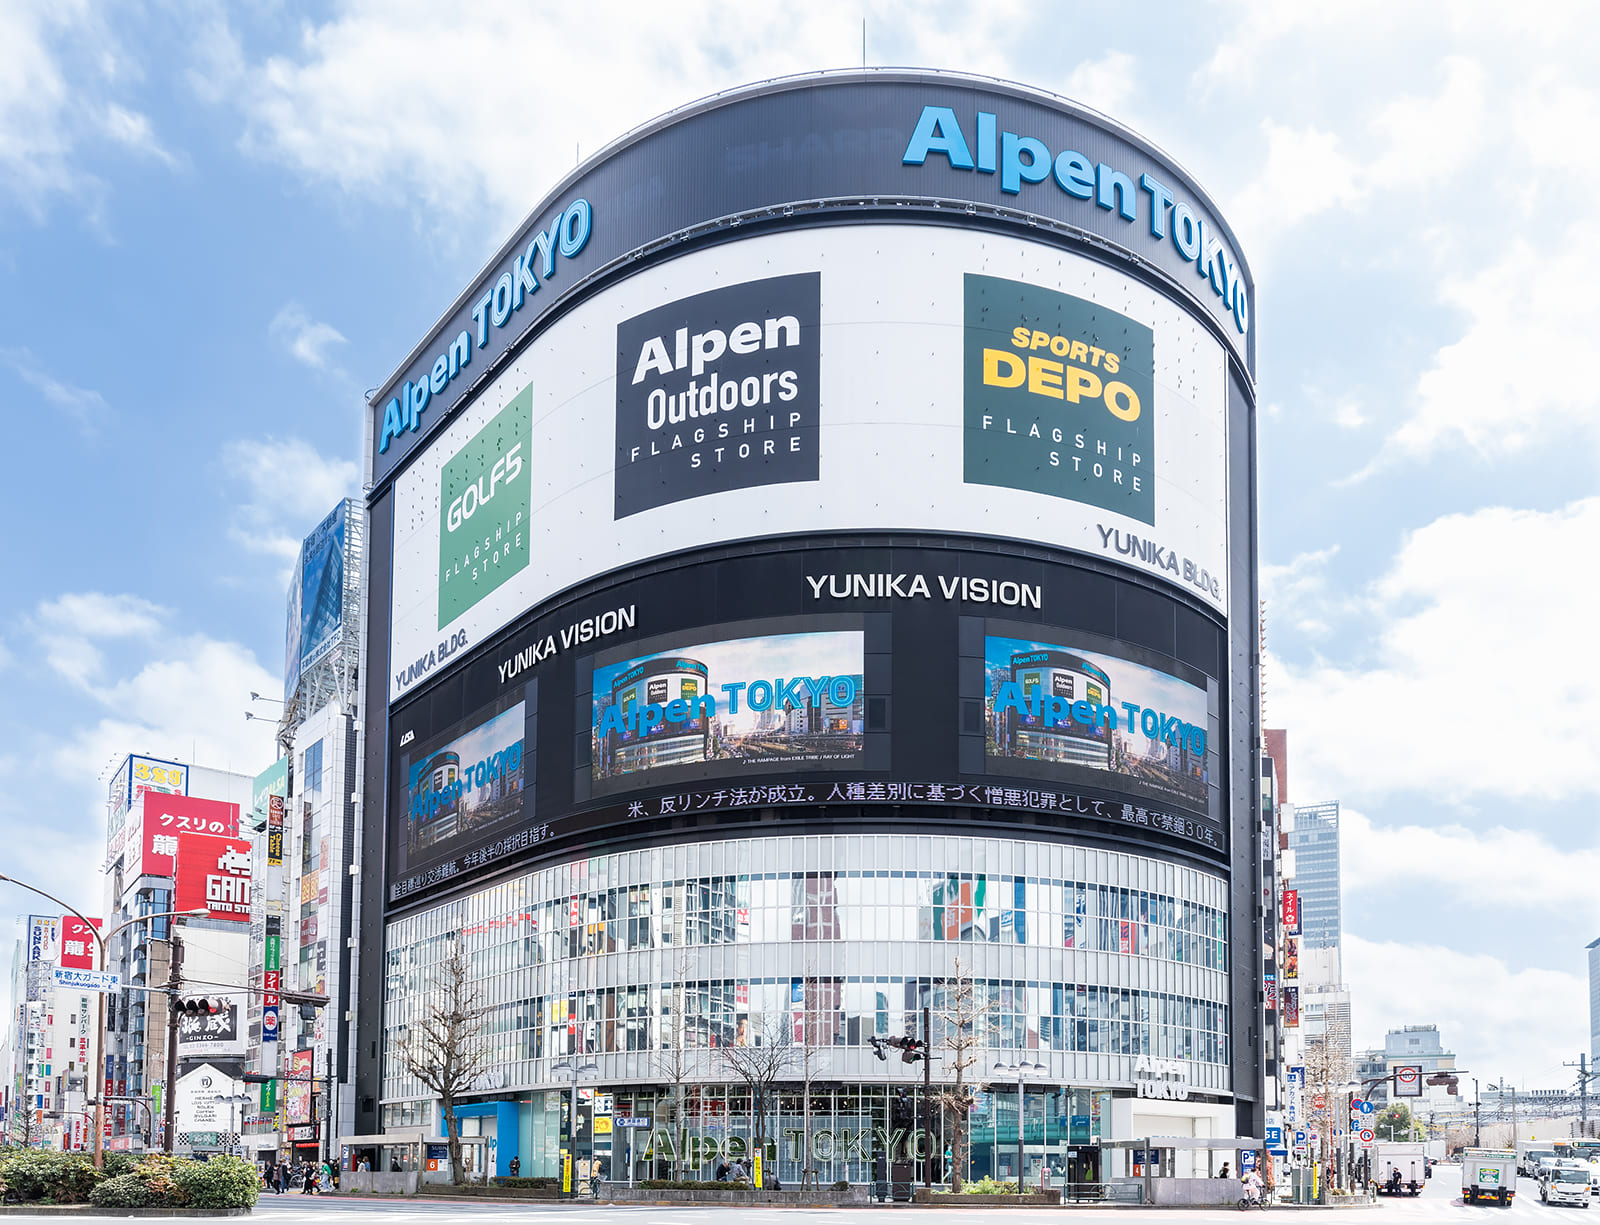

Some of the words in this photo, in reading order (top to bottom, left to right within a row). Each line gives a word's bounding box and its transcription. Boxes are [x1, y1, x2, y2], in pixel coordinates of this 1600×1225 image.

[903, 105, 1137, 222] Alpen
[1141, 172, 1249, 335] TOKYO
[378, 330, 471, 454] Alpen
[472, 198, 592, 349] TOKYO
[632, 315, 800, 385] Alpen
[1011, 326, 1120, 374] SPORTS
[647, 370, 798, 430] Outdoors
[983, 347, 1141, 422] DEPO
[631, 412, 800, 462] FLAGSHIP
[691, 437, 800, 468] STORE
[982, 415, 1141, 467] FLAGSHIP
[446, 442, 522, 533] GOLF5
[1049, 451, 1141, 492] STORE
[445, 511, 522, 582] FLAGSHIP
[472, 532, 521, 581] STORE
[1097, 523, 1179, 576] YUNIKA
[1183, 558, 1221, 602] BLDG.
[806, 573, 931, 599] YUNIKA
[937, 575, 1041, 609] VISION
[395, 650, 436, 691] YUNIKA
[436, 628, 468, 663] BLDG.
[498, 635, 557, 684] YUNIKA
[560, 604, 635, 649] VISION
[598, 693, 716, 739] Alpen
[722, 674, 855, 715] TOKYO
[992, 681, 1118, 730] Alpen
[1121, 701, 1207, 757] TOKYO
[411, 777, 464, 822] Alpen
[464, 742, 522, 793] TOKYO
[160, 813, 225, 833] クスリの
[206, 901, 232, 912] TAITO
[1286, 892, 1295, 914] ネイル
[55, 970, 118, 985] 新宿大ガード東
[267, 972, 277, 1004] アイル
[1134, 1054, 1187, 1083] Alpen
[1134, 1078, 1189, 1100] TOKYO
[642, 1128, 776, 1170] Alpen
[783, 1127, 936, 1162] TOKYO
[1296, 1132, 1305, 1144] P
[429, 1161, 436, 1169] 6
